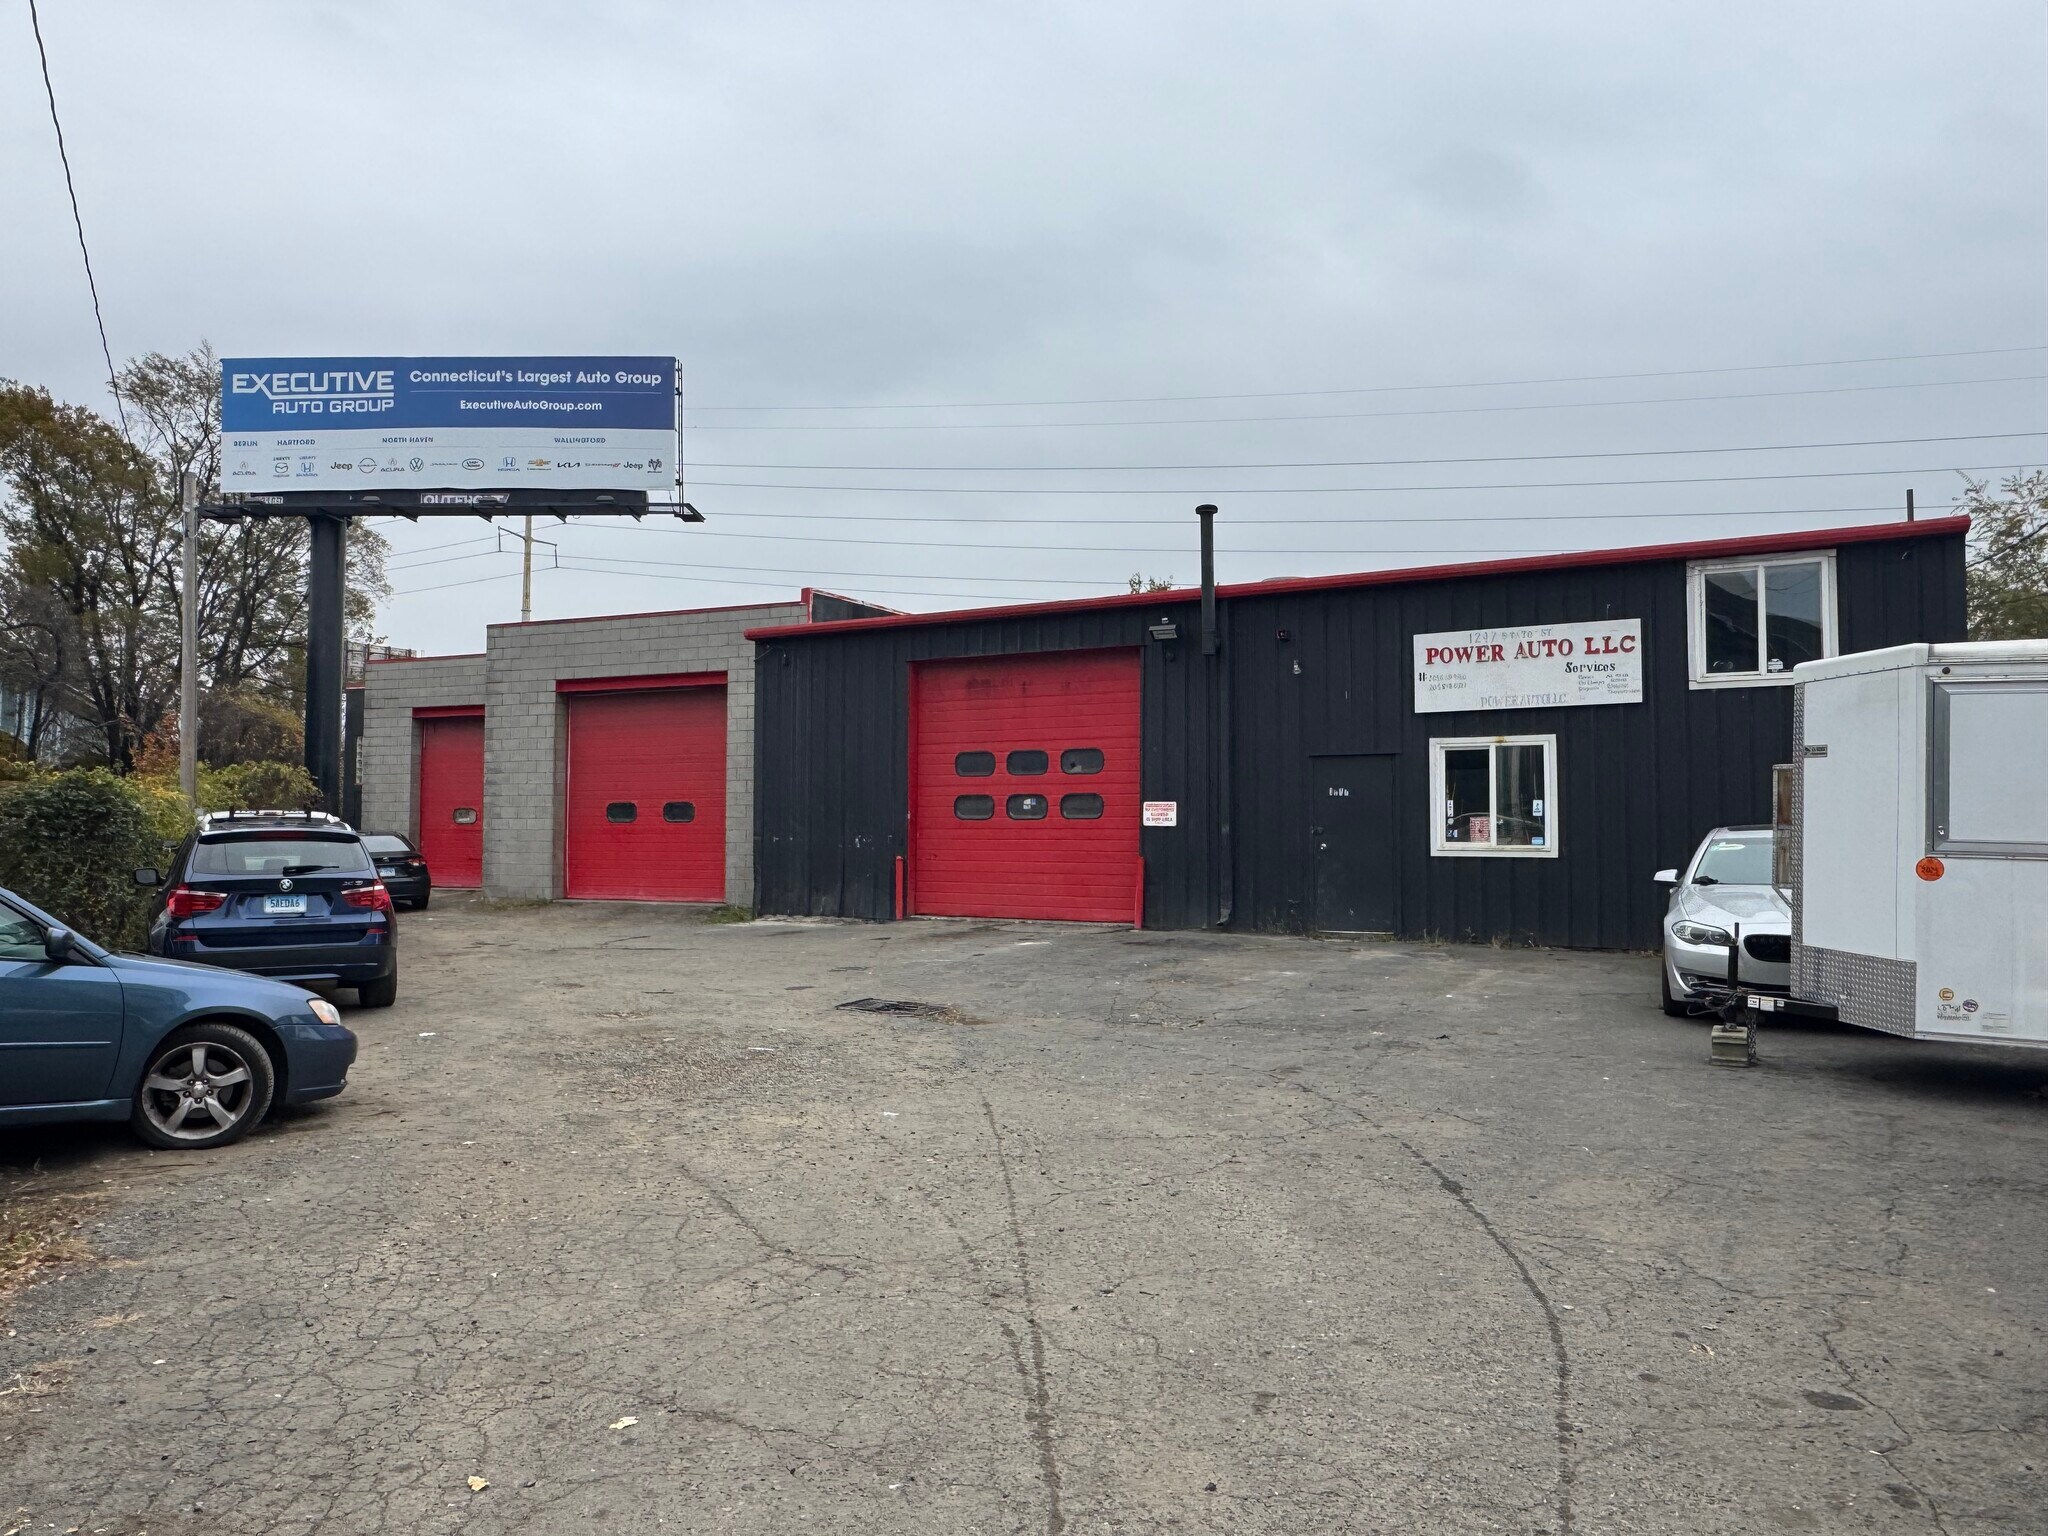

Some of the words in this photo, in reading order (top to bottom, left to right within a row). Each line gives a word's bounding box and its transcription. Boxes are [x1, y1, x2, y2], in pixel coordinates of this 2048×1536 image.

[232, 371, 394, 397] EXECUTIVE
[410, 370, 513, 383] Connecticut's
[517, 371, 571, 386] Largest
[576, 371, 611, 384] Auto
[615, 371, 662, 386] Group
[273, 402, 323, 414] AUTO
[329, 400, 394, 413] GROUP
[460, 400, 602, 412] ExecutiveAutoGroup.com
[330, 461, 353, 471] Jeep
[623, 461, 643, 470] Jeep
[1425, 644, 1505, 665] POWER
[1514, 638, 1573, 660] AUTO
[1584, 635, 1636, 655] LLC
[1564, 660, 1616, 673] Services
